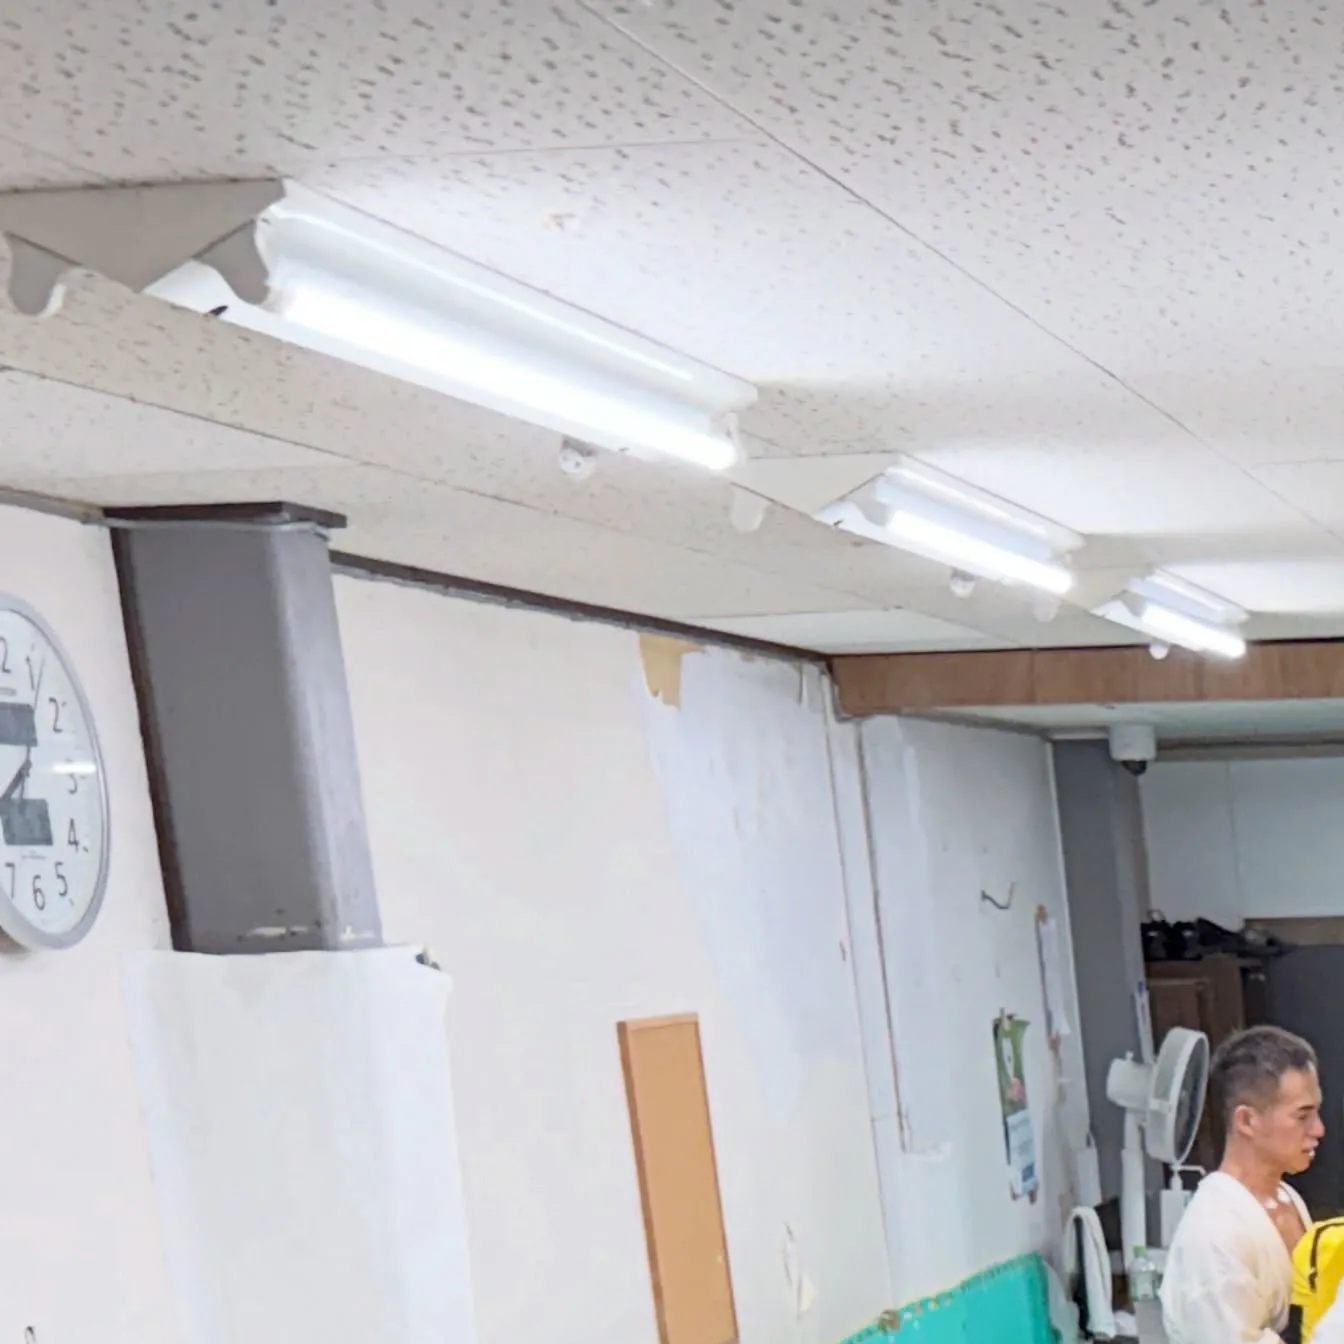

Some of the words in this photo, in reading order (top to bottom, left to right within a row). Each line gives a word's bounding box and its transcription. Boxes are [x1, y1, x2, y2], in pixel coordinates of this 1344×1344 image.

[25, 655, 35, 691] 1
[48, 697, 63, 733] 2
[67, 818, 79, 852] 4
[5, 862, 16, 900] 7
[32, 875, 46, 911] 6
[54, 861, 68, 897] 5
